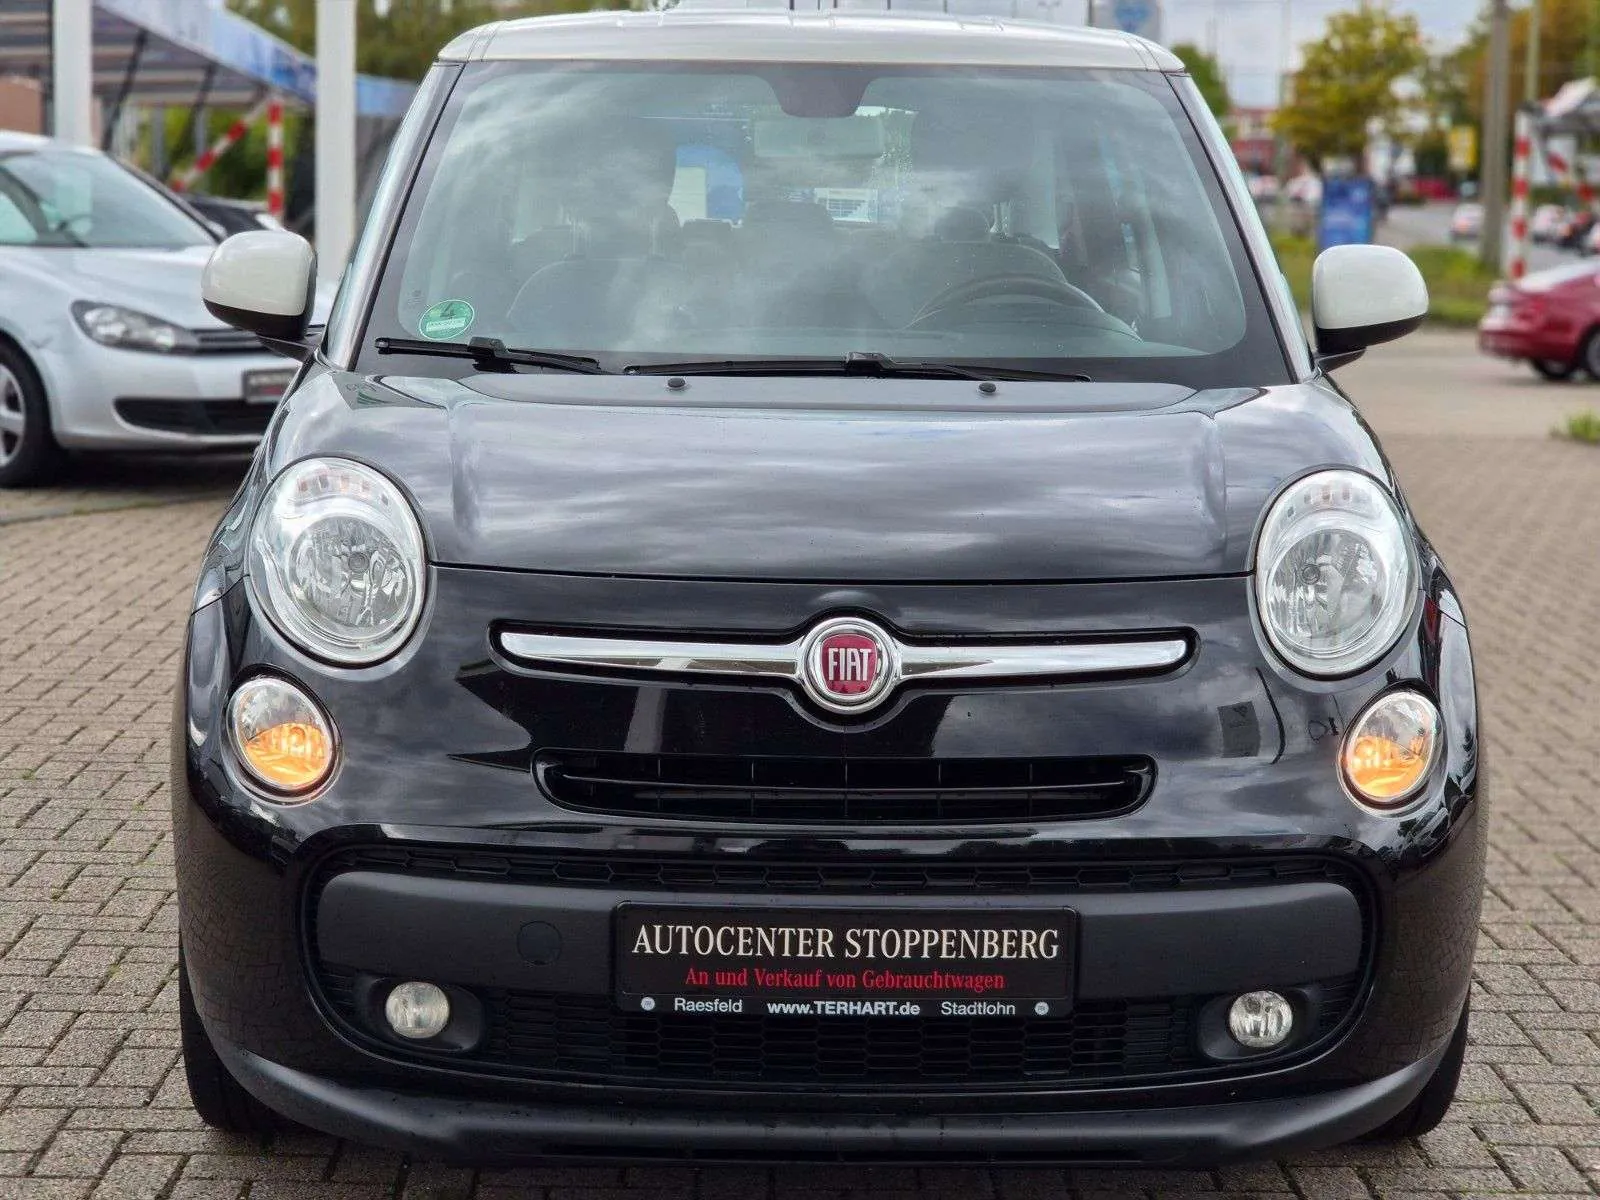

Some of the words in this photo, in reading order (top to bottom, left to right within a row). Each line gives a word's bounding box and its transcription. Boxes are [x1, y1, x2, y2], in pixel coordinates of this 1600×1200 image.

[828, 647, 872, 681] FIAT
[632, 925, 835, 958] AUTOCENTER
[845, 928, 1059, 959] STOPPENBERG
[685, 967, 708, 985] An
[715, 968, 748, 986] und
[754, 969, 823, 988] Verkauf
[827, 973, 856, 988] von
[862, 970, 1005, 993] Gebrauchtwagen
[674, 998, 743, 1013] Raesfeld
[767, 1001, 921, 1016] www.TERHART.de
[941, 1001, 1016, 1016] Stadtlohn
